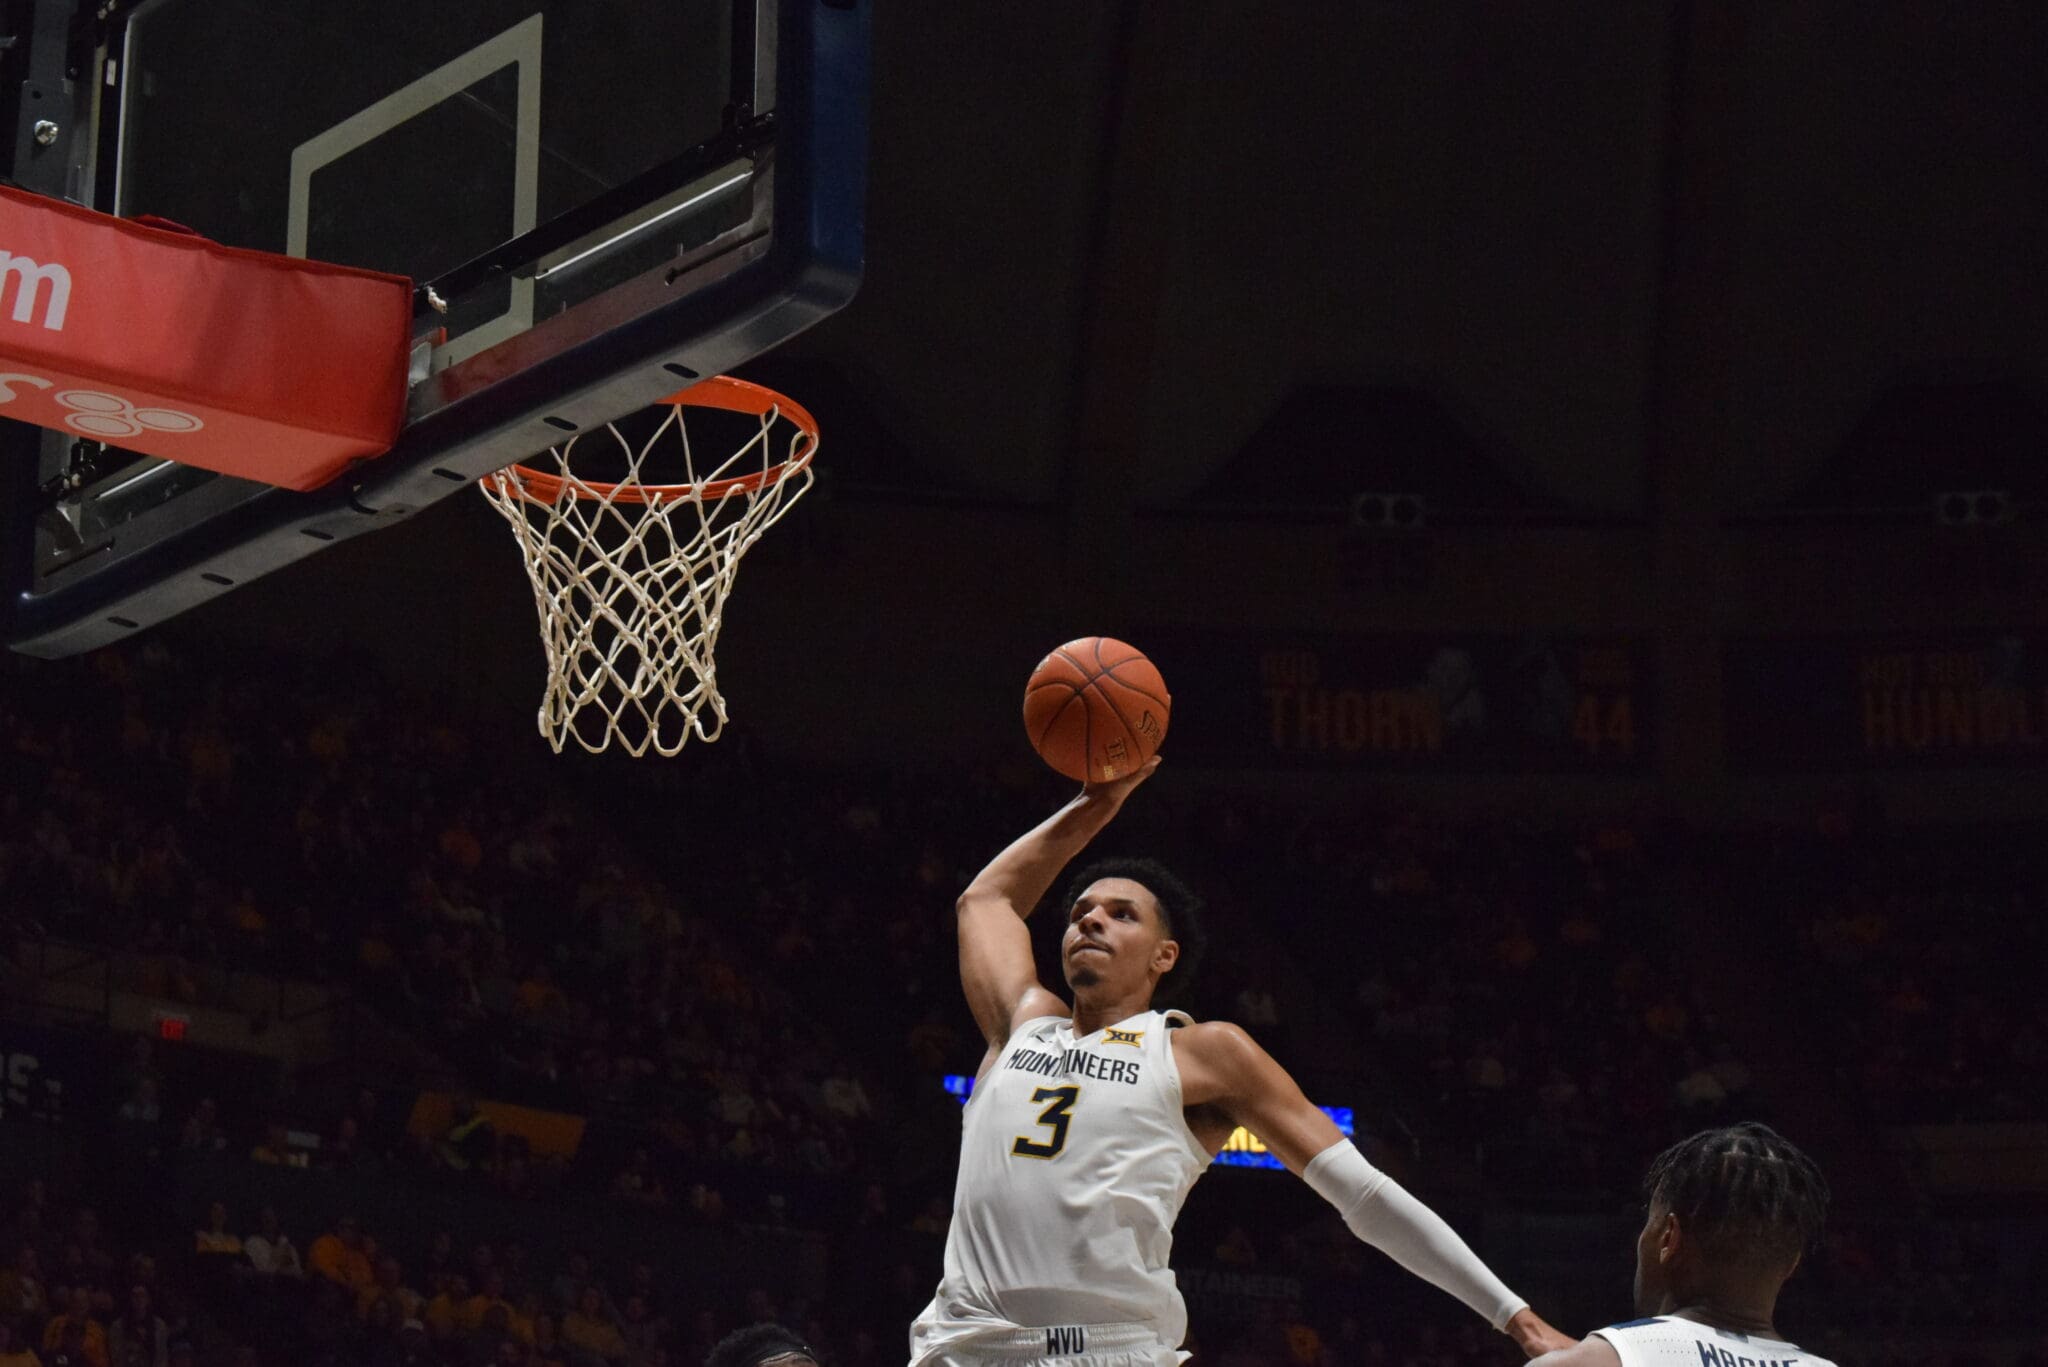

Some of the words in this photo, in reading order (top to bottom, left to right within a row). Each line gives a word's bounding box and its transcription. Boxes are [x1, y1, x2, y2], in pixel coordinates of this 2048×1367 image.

[1262, 688, 1440, 751] THORN
[1571, 693, 1635, 755] 44
[1863, 686, 2048, 751] HUNDL
[1010, 1085, 1081, 1160] 3
[1046, 1327, 1084, 1355] WVU
